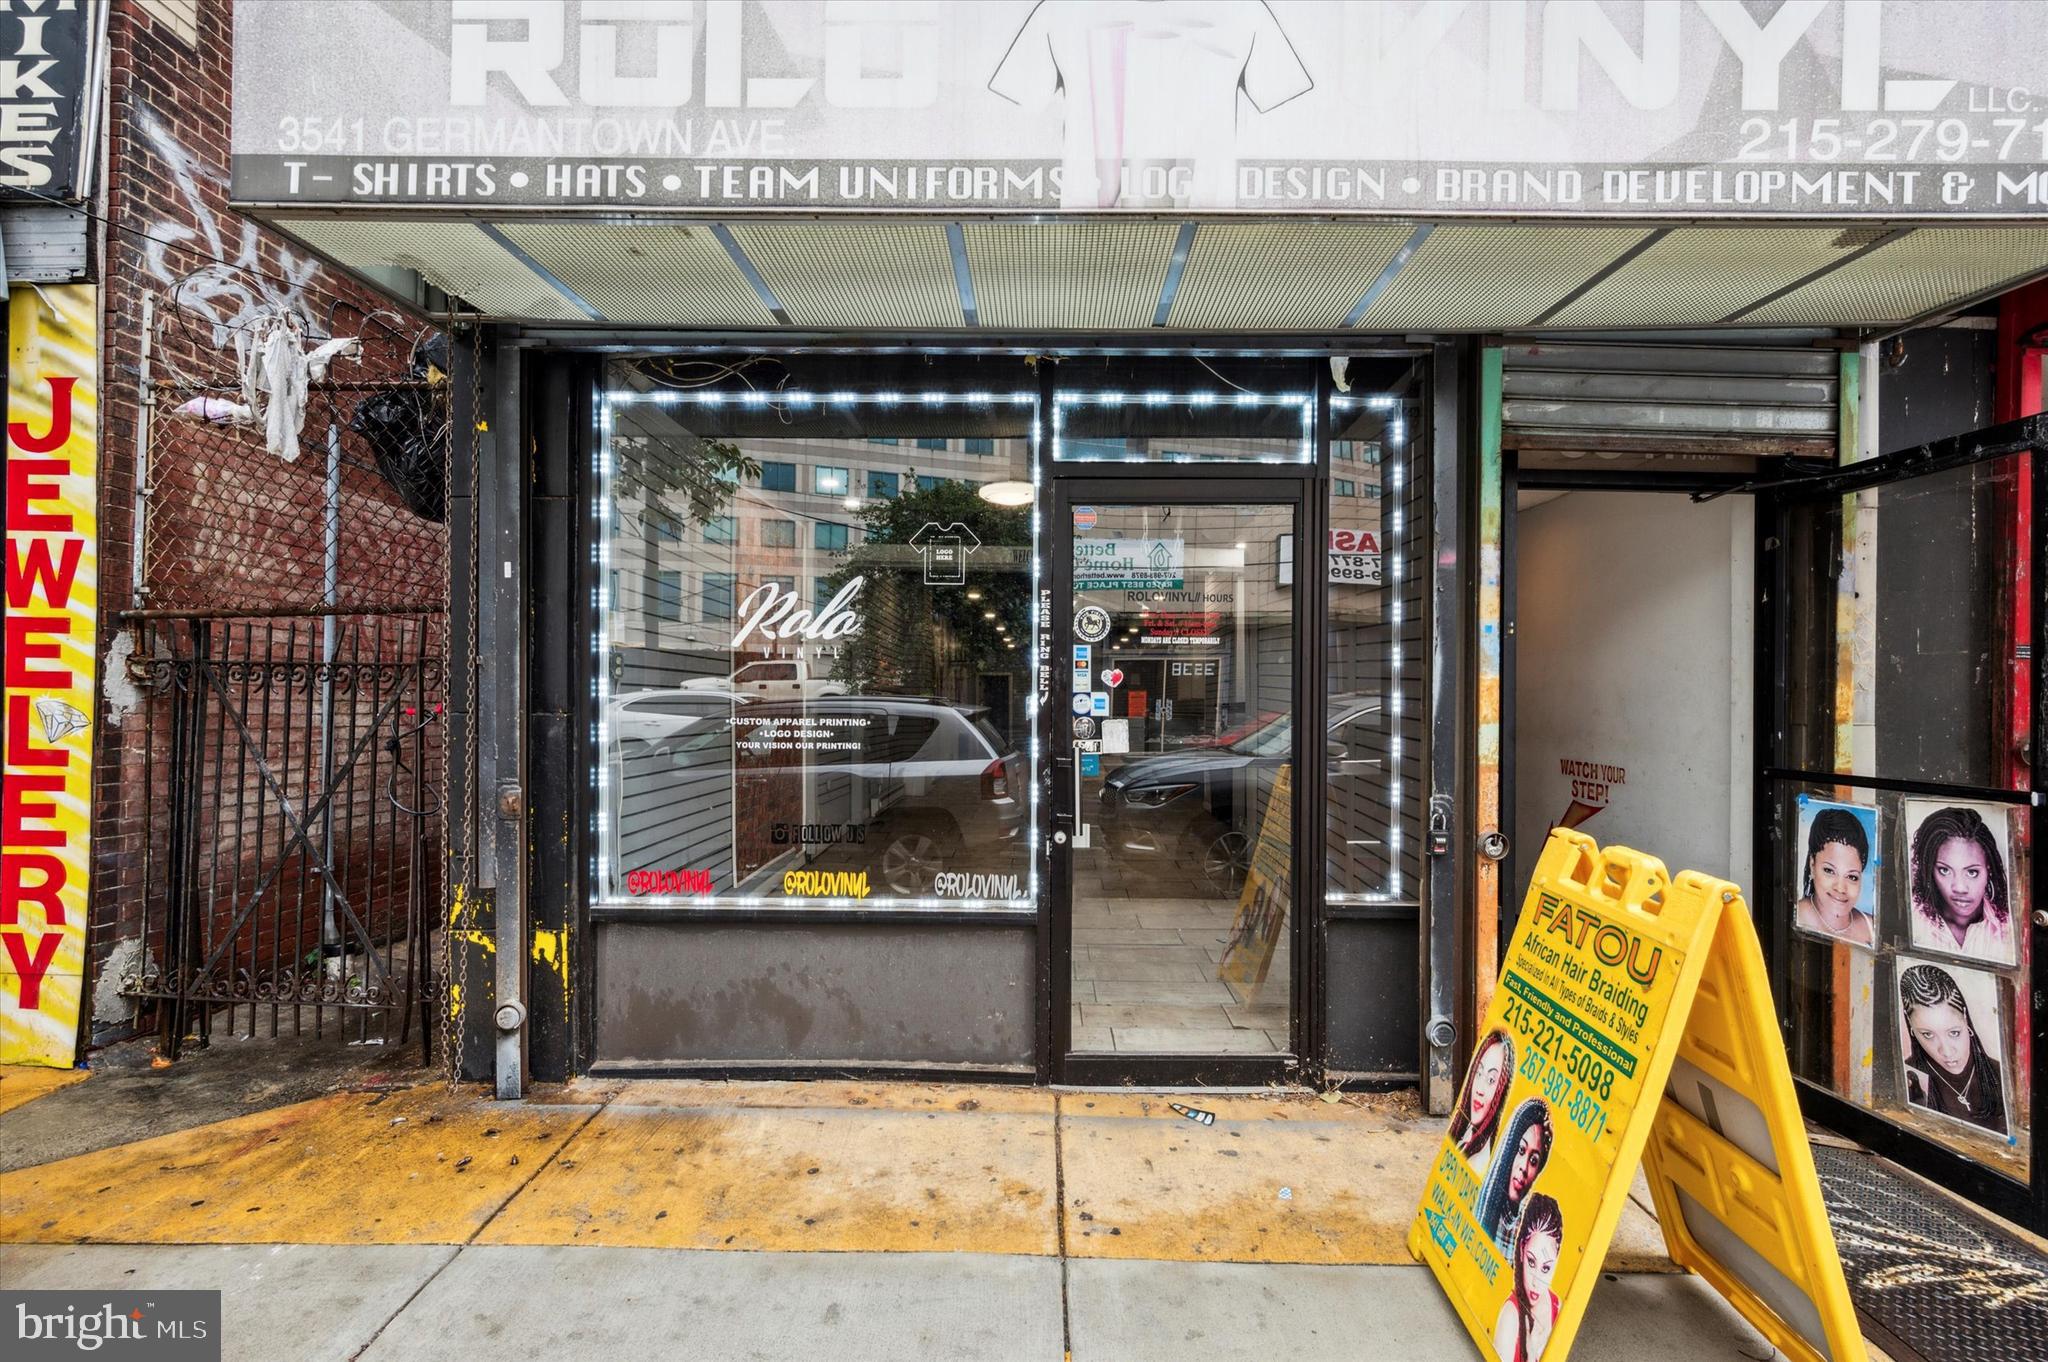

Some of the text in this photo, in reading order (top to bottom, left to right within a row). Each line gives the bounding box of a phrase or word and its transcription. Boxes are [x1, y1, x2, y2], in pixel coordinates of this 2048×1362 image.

[0, 0, 76, 186] IKES
[278, 117, 365, 153] 3541
[383, 117, 692, 155] GERMANTOWN
[353, 163, 497, 196] SHIRTS
[546, 165, 646, 197] HATS
[694, 166, 819, 199] TEAM
[840, 167, 1063, 199] UNIFORMS
[1122, 167, 1194, 200] LOG
[1240, 168, 1386, 200] DESIGN
[1437, 169, 1583, 202] BRAND
[1942, 171, 1975, 204] &
[731, 575, 863, 647] Rolo
[1203, 593, 1233, 603] HOURS
[763, 647, 840, 659] VINYL
[1039, 590, 1051, 690] PLEASE RING BELL
[1, 377, 84, 1009] JEWELERY
[730, 718, 867, 726] CUSTOM APPAREL PRINTING
[764, 730, 830, 738] LOGO DESIGN
[736, 741, 862, 750] YOUR VISION OUR PRINTING!
[1560, 759, 1626, 785] WATCH YOUR
[1571, 780, 1609, 804] STEP!
[791, 824, 866, 844] FOLLOW US
[627, 868, 714, 897] @ROLOVINYL
[784, 870, 871, 898] @ROLOVINYL
[1533, 892, 1662, 985] FATOU
[1516, 953, 1544, 982] Specialized
[1549, 973, 1559, 991] All
[1558, 980, 1577, 1004] Types
[1577, 994, 1587, 1008] of
[1585, 995, 1608, 1024] Braids
[1608, 1012, 1617, 1029] &
[1616, 1016, 1639, 1045] Styles
[1523, 931, 1649, 1029] African Hair Braiding
[1505, 974, 1634, 1072] Fast, Friendly and Professional
[1503, 996, 1614, 1101] 215-221-5098
[1520, 1046, 1607, 1143] 267-987-8871
[1431, 1182, 1463, 1233] WALK-IN
[1461, 1219, 1500, 1287] WELCOME
